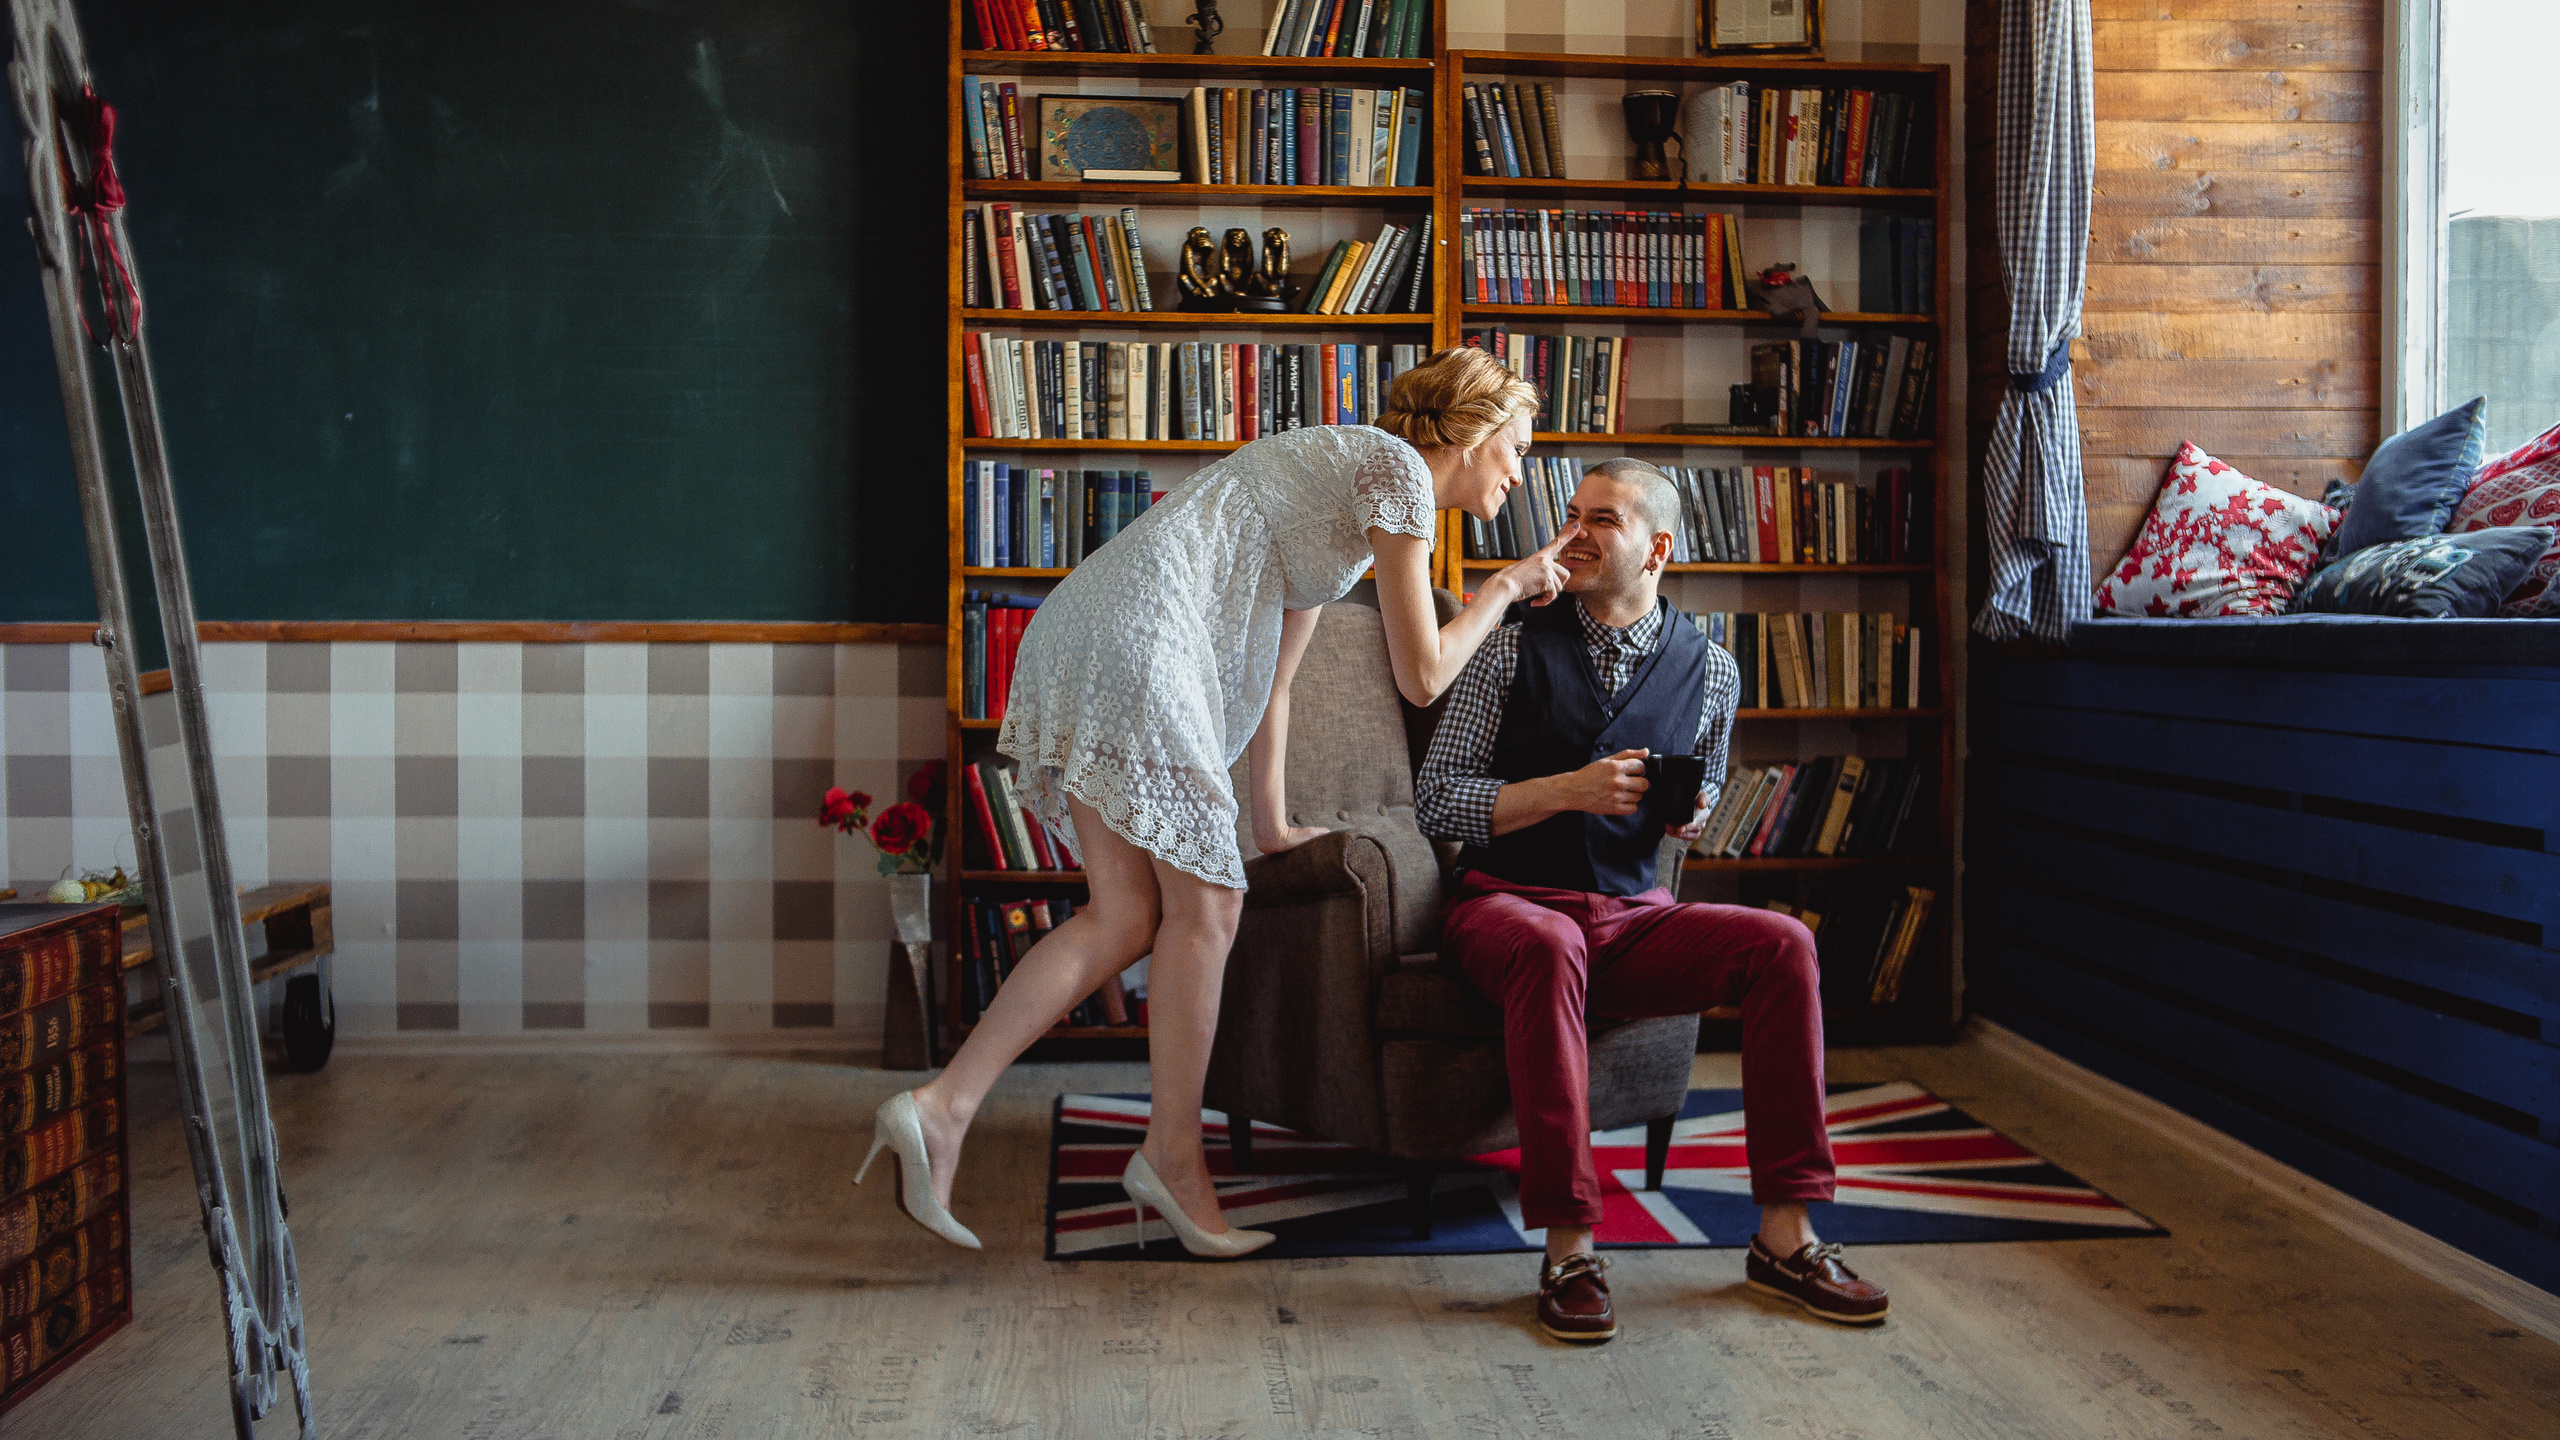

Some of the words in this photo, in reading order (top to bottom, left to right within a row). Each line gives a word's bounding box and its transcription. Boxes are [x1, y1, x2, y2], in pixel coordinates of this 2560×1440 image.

[1285, 97, 1294, 149] ПАСТЕРНАК
[1738, 110, 1747, 155] ENGLISH
[1286, 152, 1295, 181] БОРИС
[1289, 354, 1299, 391] РЕМАРК
[1043, 522, 1051, 561] ЭТИКЕТ
[46, 1016, 59, 1049] 1856
